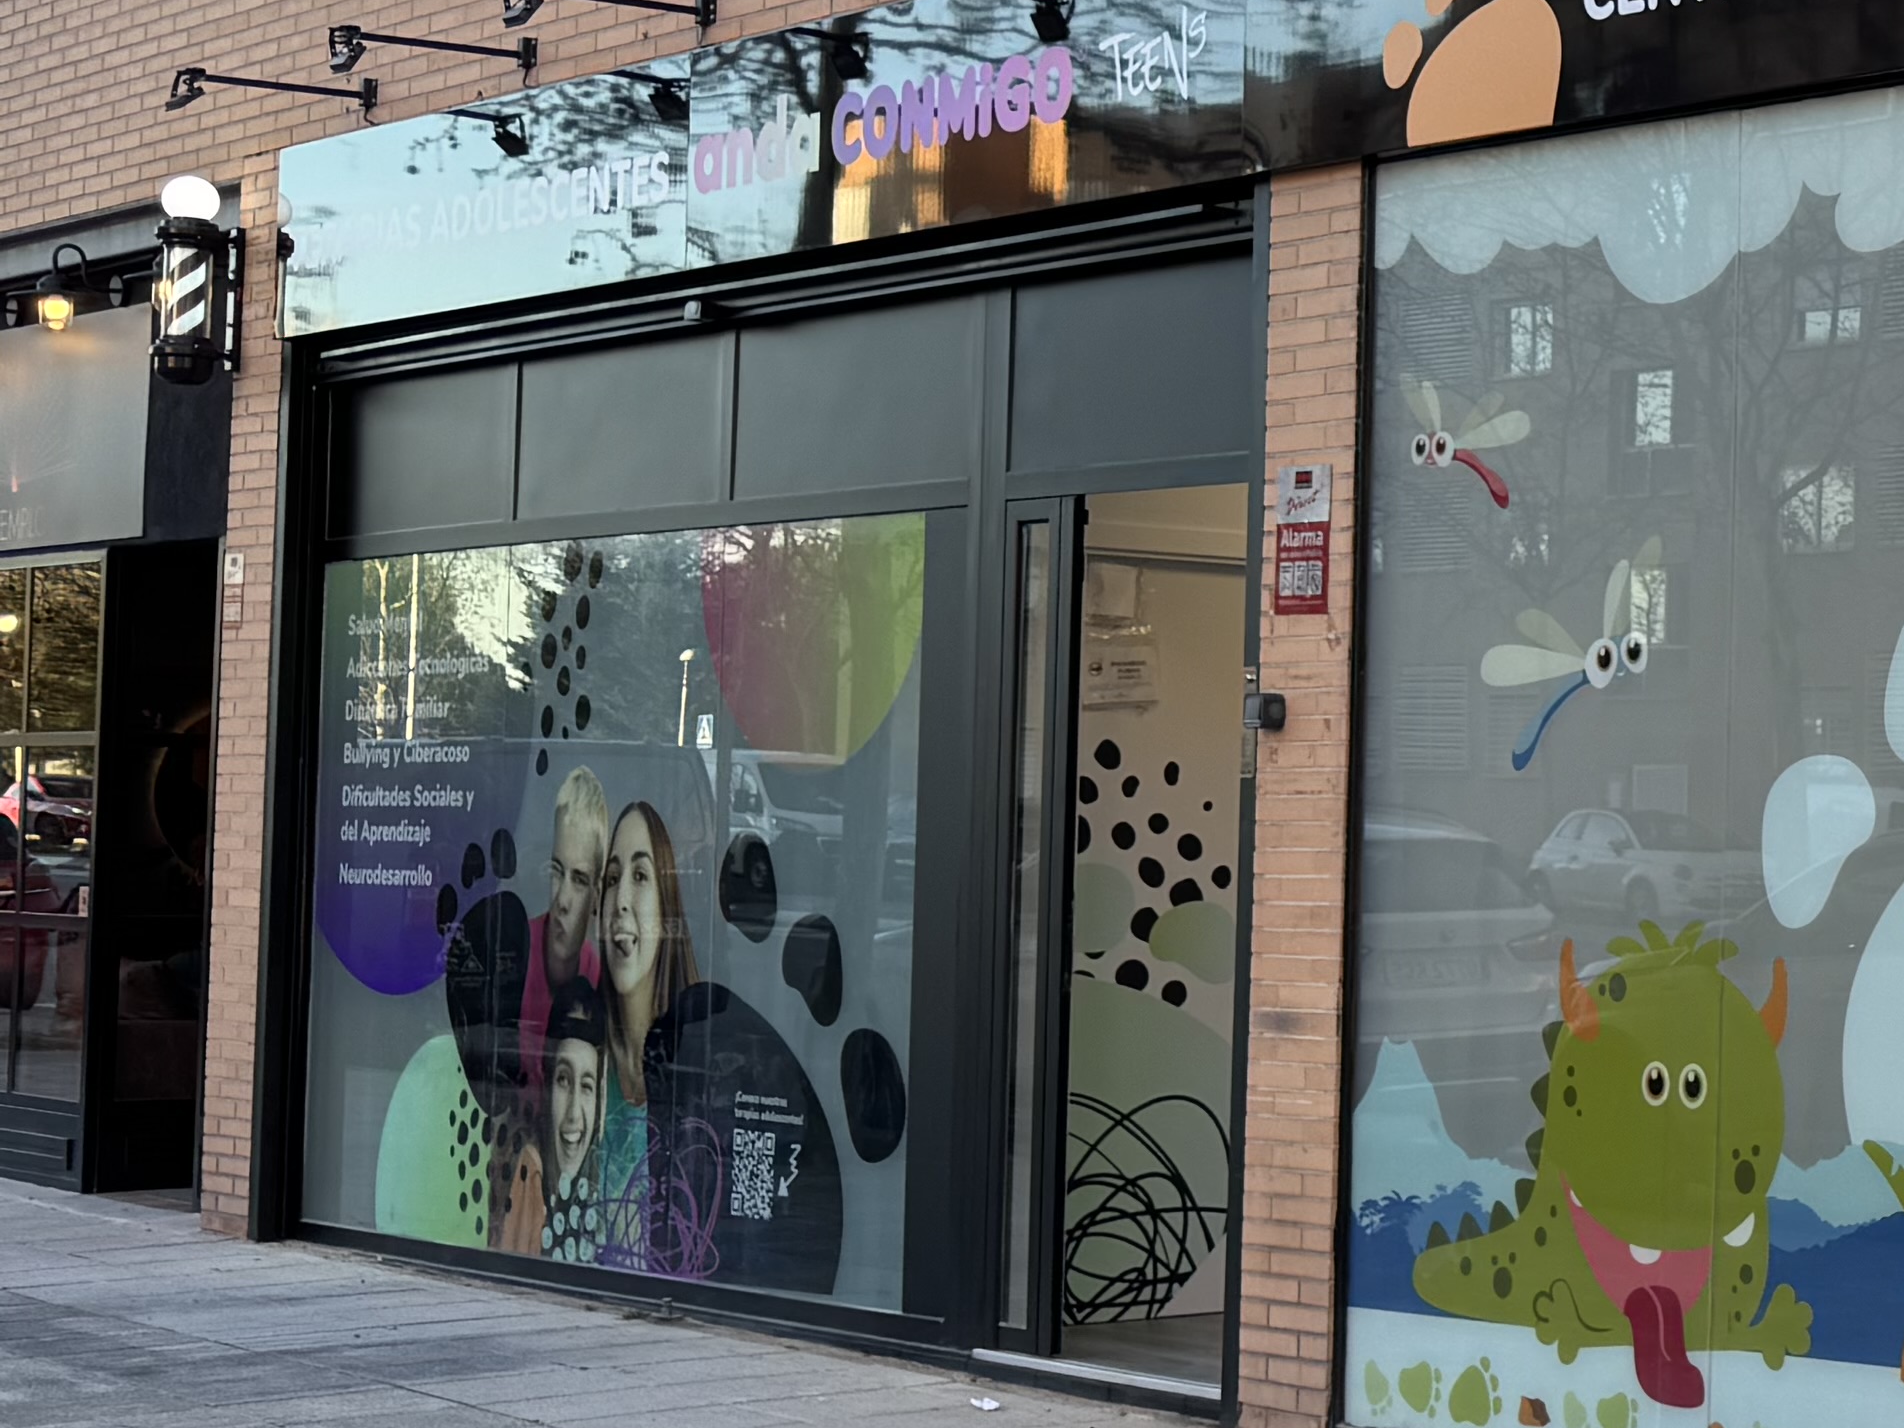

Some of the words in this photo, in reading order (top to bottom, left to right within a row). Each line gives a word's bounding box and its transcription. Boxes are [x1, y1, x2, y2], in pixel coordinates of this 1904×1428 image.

[694, 94, 821, 194] anda
[429, 151, 671, 241] ADOLESCENTES
[1280, 528, 1324, 548] Alarma
[343, 741, 390, 769] Bullying
[393, 747, 401, 769] y
[403, 740, 470, 763] Ciberacoso
[342, 784, 411, 807] Dificultades
[413, 783, 464, 807] Sociales
[465, 790, 475, 812] y
[340, 820, 358, 842] del
[360, 819, 432, 847] Aprendizaje
[338, 862, 433, 887] Neurodesarrollo
